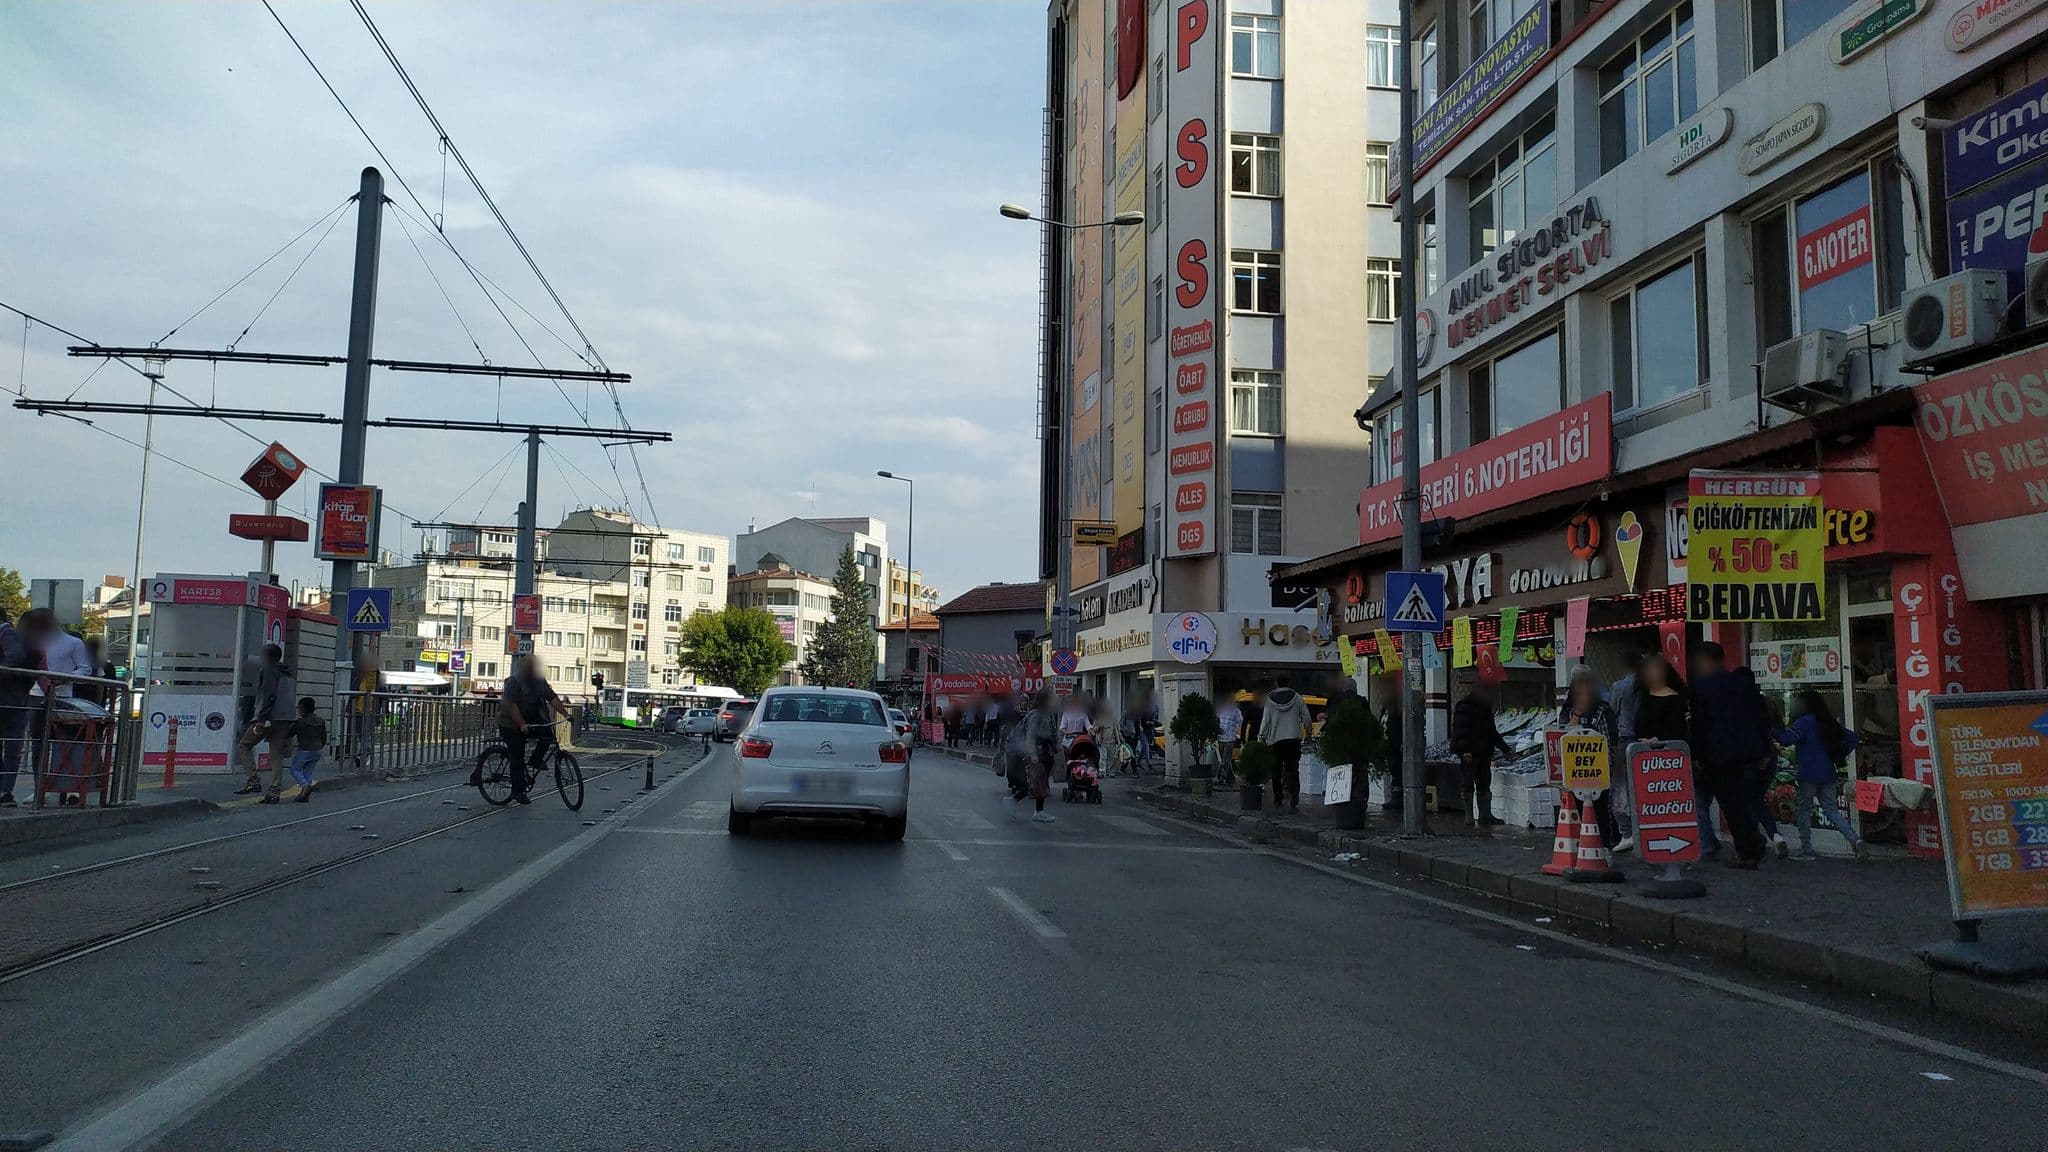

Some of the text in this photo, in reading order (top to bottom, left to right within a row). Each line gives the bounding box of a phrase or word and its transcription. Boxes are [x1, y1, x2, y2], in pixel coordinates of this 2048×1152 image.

[1680, 122, 1703, 149] HDI
[1449, 196, 1603, 315] ANIL SİGORTA
[1803, 217, 1869, 280] 6.NOTER
[1447, 218, 1611, 349] MEHMET SELVİ
[1179, 365, 1204, 386] ÖABT
[1919, 369, 2048, 442] ÖZKÖS
[1176, 406, 1207, 425] A GRUBU
[1172, 450, 1212, 469] MEMURLUK
[1393, 461, 1460, 522] KSERİ
[1464, 411, 1590, 498] 6.NOTERLİĞİ
[1962, 435, 2048, 485] İŞ ME
[1179, 488, 1203, 506] ALES
[1704, 480, 1807, 497] HERGÜN
[324, 501, 355, 515] kitap
[1692, 502, 1819, 535] ÇİĞKÖFTENİZİN
[1181, 528, 1201, 544] DGS
[180, 586, 223, 597] KART38
[1690, 582, 1822, 621] BEDAVA
[519, 643, 532, 652] 20
[1171, 634, 1209, 655] elfin
[943, 678, 978, 688] vodafone
[1950, 723, 1983, 740] TÜRK
[1567, 739, 1603, 753] NİYAZİ
[1951, 735, 2040, 753] TELEKOM'DAN
[1575, 755, 1596, 767] BEY
[1641, 755, 1684, 773] yüksel
[1955, 761, 2023, 778] PAKETLERİ
[1571, 768, 1603, 779] KEBAP
[1646, 778, 1683, 793] erkek
[1641, 799, 1693, 817] kuaförü
